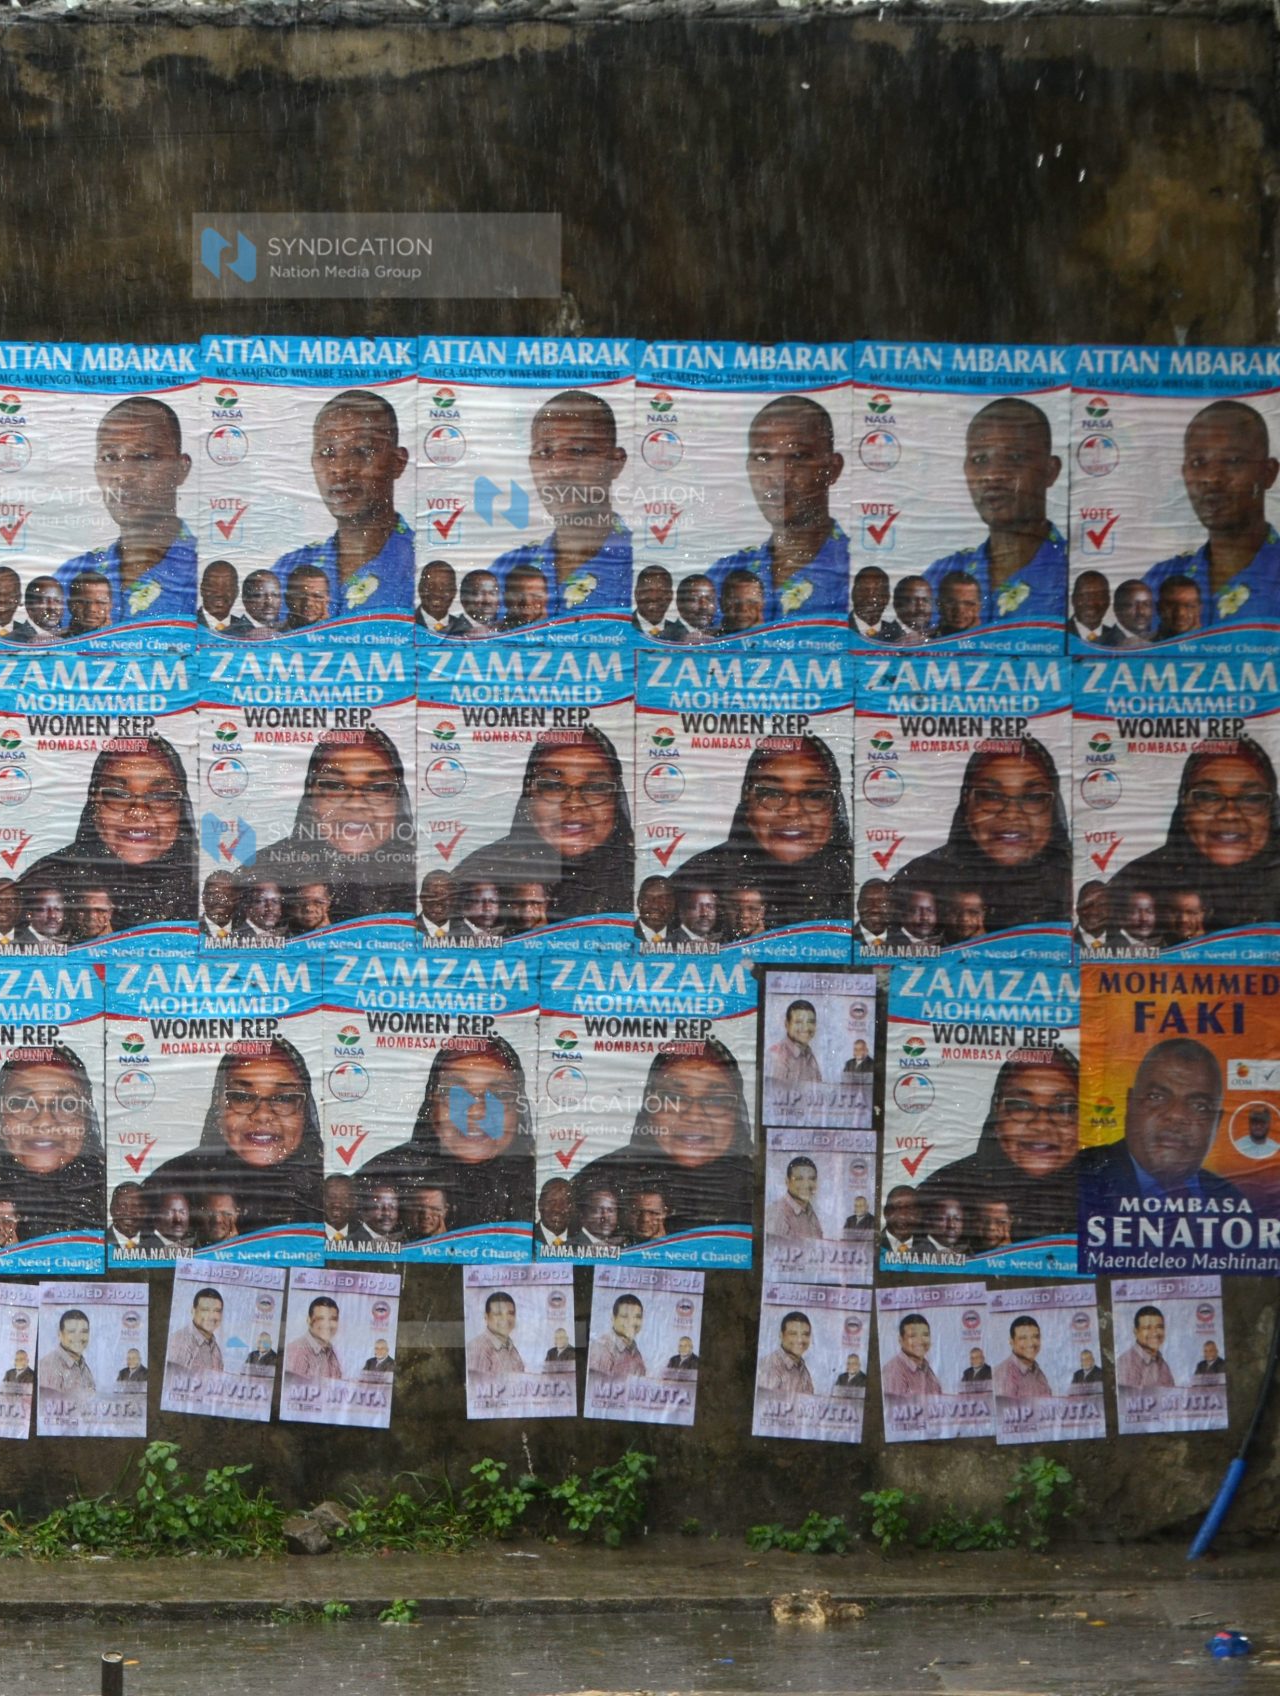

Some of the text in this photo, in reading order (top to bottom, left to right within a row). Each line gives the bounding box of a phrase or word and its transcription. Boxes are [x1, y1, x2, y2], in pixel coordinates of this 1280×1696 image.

[82, 347, 195, 371] MBARAK
[205, 339, 412, 365] ATTAN MBARAK
[423, 340, 630, 366] ATTAN MBARAK
[640, 344, 848, 371] ATTAN MBARAK
[859, 345, 1066, 373] ATTAN MBARAK
[1076, 349, 1280, 376] ATTAN MBARAK
[212, 410, 243, 418] NASA
[865, 415, 896, 423] NASA
[210, 498, 241, 509] VOTE
[862, 503, 893, 514] VOTE
[307, 633, 409, 645] We Need Change
[958, 640, 1060, 653] We Need Change
[428, 649, 623, 683] ZAMZAM
[1082, 660, 1277, 694] ZAMZAM
[450, 684, 601, 704] MOHAMMED
[1105, 694, 1256, 714] MOHAMMED
[244, 706, 375, 729] WOMEN REP.
[473, 730, 584, 743] MOMBASA COUNTY
[648, 827, 679, 838] VOTE
[333, 956, 528, 990] ZAMZAM
[551, 960, 746, 994] ZAMZAM
[1098, 972, 1280, 996] MOHAMMED
[355, 990, 506, 1010] MOHAMMED
[573, 994, 724, 1014] MOHAMMED
[1134, 1001, 1245, 1034] FAKI
[584, 1016, 716, 1040] WOMEN REP.
[1119, 1197, 1253, 1213] MOMBASA
[1087, 1216, 1280, 1250] SENATOR
[1087, 1251, 1187, 1270] Maendeleo
[287, 1384, 320, 1401] MP
[1125, 1396, 1156, 1412] MP
